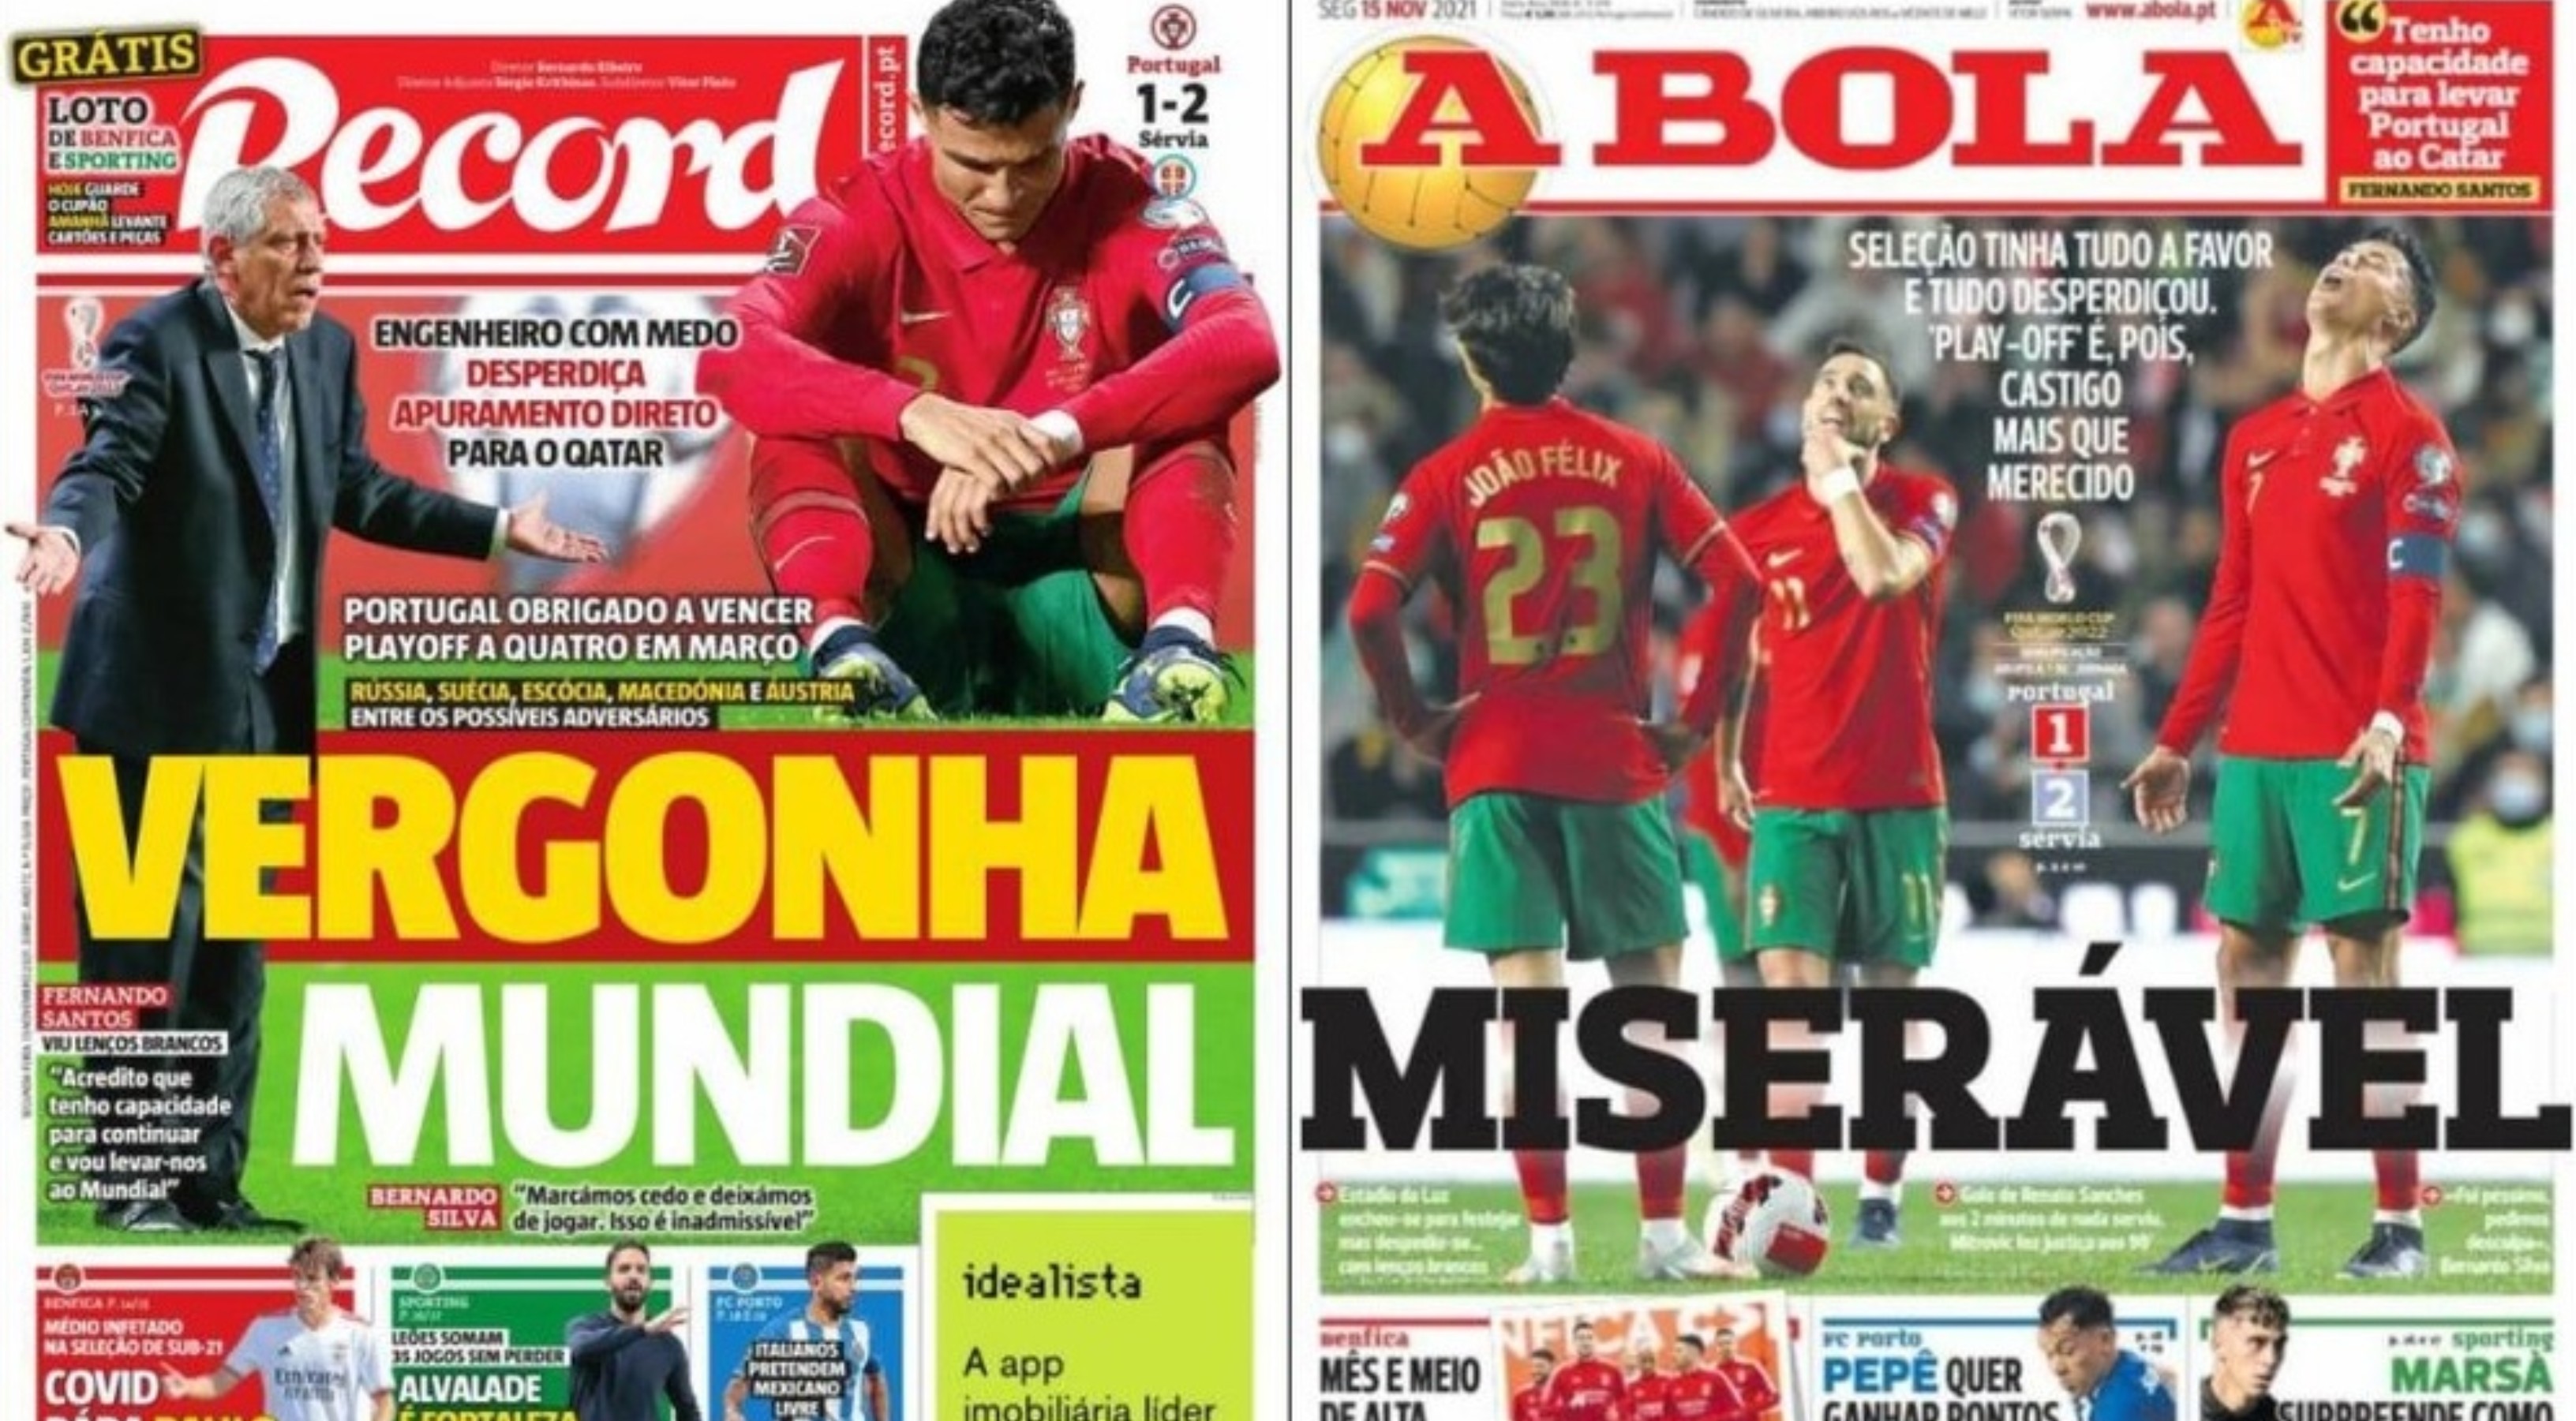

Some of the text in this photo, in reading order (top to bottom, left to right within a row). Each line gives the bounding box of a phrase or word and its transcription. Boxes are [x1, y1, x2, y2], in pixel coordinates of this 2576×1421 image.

[1318, 0, 1477, 19] SEG 15 NOV 2021
[2085, 0, 2216, 23] www.abola.pt
[2389, 17, 2491, 43] Tenho
[17, 32, 197, 78] GRÁTIS
[1127, 55, 1221, 77] Portugal
[2349, 49, 2529, 80] capacidade
[48, 96, 148, 125] LOTO
[877, 44, 901, 152] ecord.pt
[1136, 83, 1209, 124] 1-2
[1361, 47, 2303, 171] A BOLA
[2358, 80, 2520, 114] para levar
[48, 129, 177, 148] DE BENFICA
[1139, 131, 1209, 148] Sérvia
[2369, 112, 2509, 145] Portugal
[178, 57, 844, 232] Record
[2373, 144, 2506, 170] ao Catar
[64, 151, 177, 169] SPORTING
[84, 182, 139, 196] GUARDE
[2349, 182, 2533, 198] FERNANDO SANTOS
[1849, 224, 2274, 275] SELEÇÃO TINHA TUDO A FAVOR
[1904, 278, 2218, 322] E TUDO DESPERDIÇOU.
[375, 320, 738, 346] ENGENHEIRO COM MEDO
[2087, 317, 2114, 365] É,
[2120, 324, 2195, 365] POIS,
[466, 360, 646, 395] DESPERDIÇA
[2000, 370, 2122, 408] CASTIGO
[395, 399, 717, 428] APURAMENTO DIRETO
[1994, 417, 2129, 458] MAIS QUE
[448, 439, 664, 467] PARA O QATAR
[1463, 439, 1624, 508] JOÃO FÉLIX
[1987, 463, 2134, 502] MERECIDO
[2387, 538, 2404, 570] C
[1477, 506, 1623, 665] 23
[345, 597, 813, 624] PORTUGAL OBRIGADO A VENCER
[345, 634, 799, 668] PLAYOFF A QUATRO EM MARÇO
[351, 677, 854, 705] RÚSSIA, SUÉCIA, ESCÓCIA, MACEDÓNIA ÁUSTRIA
[350, 704, 710, 727] ENTRE OS POSSÍVEIS ADVERSÁRIOS
[2048, 712, 2073, 754] 1
[2045, 777, 2076, 819] 2
[57, 752, 1229, 943] VERGONHA
[2339, 807, 2368, 866] 7
[43, 988, 168, 1005] FERNANDO
[42, 1010, 133, 1028] SANTOS
[42, 1036, 223, 1054] VIU LENÇOS BRANCOS
[1301, 942, 2572, 1151] MISERÁVEL
[152, 1070, 193, 1093] que
[292, 982, 1236, 1167] MUNDIAL
[49, 1096, 232, 1120] tenho capacidade
[49, 1124, 201, 1147] para continuar
[66, 1151, 207, 1171] vou levar-nos
[49, 1184, 74, 1200] ao
[370, 1187, 498, 1206] BERNARDO
[639, 1185, 687, 1206] cedo
[710, 1185, 812, 1206] deixámos
[426, 1210, 497, 1228] SILVA
[514, 1210, 538, 1230] de
[541, 1210, 606, 1235] jogar.
[609, 1210, 650, 1230] Isso
[654, 1210, 668, 1230] é
[963, 1262, 1142, 1299] idealista
[43, 1315, 184, 1334] MÉDIO INFETADO
[392, 1329, 504, 1345] LEÕES SOMAM
[43, 1337, 223, 1358] NA SELEÇÃO DE SUB-21
[414, 1349, 564, 1363] JOGOS SEM PERDER
[754, 1342, 839, 1358] ITALIANOS
[749, 1362, 846, 1377] PRETENDEM
[964, 1347, 1065, 1385] A app
[1320, 1348, 1481, 1393] MÊS MEIO
[1823, 1348, 2023, 1398] PEPÊ QUER
[2391, 1349, 2554, 1393] MARSÀ
[44, 1369, 158, 1404] COVID
[398, 1374, 542, 1402] ALVALADE
[752, 1382, 841, 1397] MEXICANO
[776, 1401, 818, 1415] LIVRE
